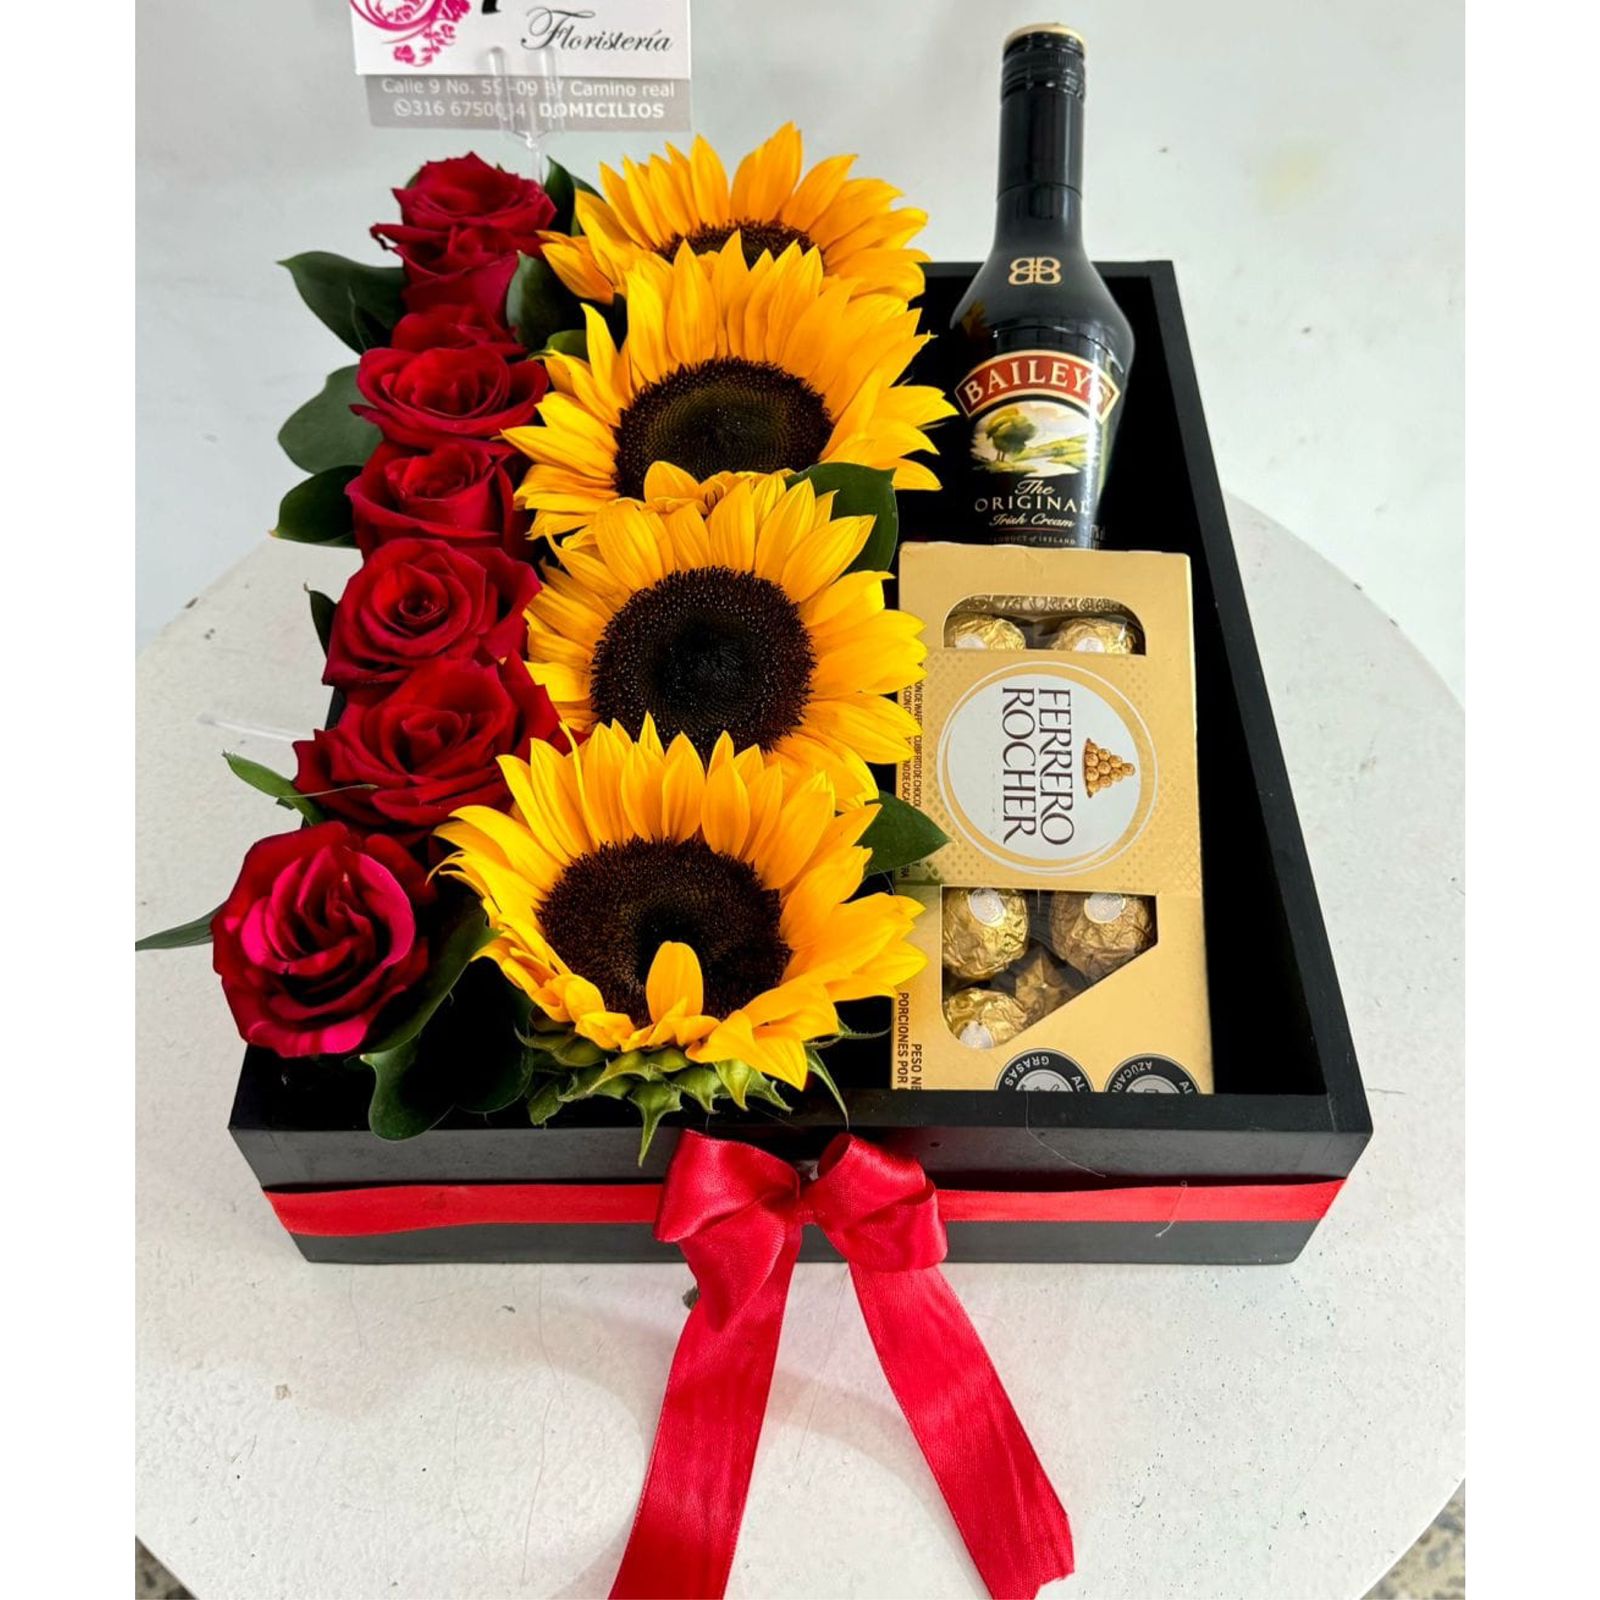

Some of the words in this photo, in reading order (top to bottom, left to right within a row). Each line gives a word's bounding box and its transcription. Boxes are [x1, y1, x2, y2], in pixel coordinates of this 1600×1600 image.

[521, 6, 673, 51] Floristería
[382, 79, 423, 95] Calle
[430, 80, 440, 94] 9
[447, 80, 475, 95] No.
[571, 80, 637, 97] Camino
[643, 81, 675, 98] real
[413, 102, 444, 117] 316
[540, 102, 664, 119] DOMICILIOS
[1015, 479, 1055, 495] The
[974, 495, 1090, 515] ORIGINAL
[988, 512, 1026, 527] Irish
[1030, 512, 1076, 528] Cream
[1002, 687, 1036, 845] ROCHER
[1039, 688, 1075, 846] FERRERO
[897, 992, 909, 1057] PORCIONES
[911, 1043, 923, 1073] PESO
[1004, 1055, 1050, 1087] GRASAS
[897, 1060, 909, 1084] POR
